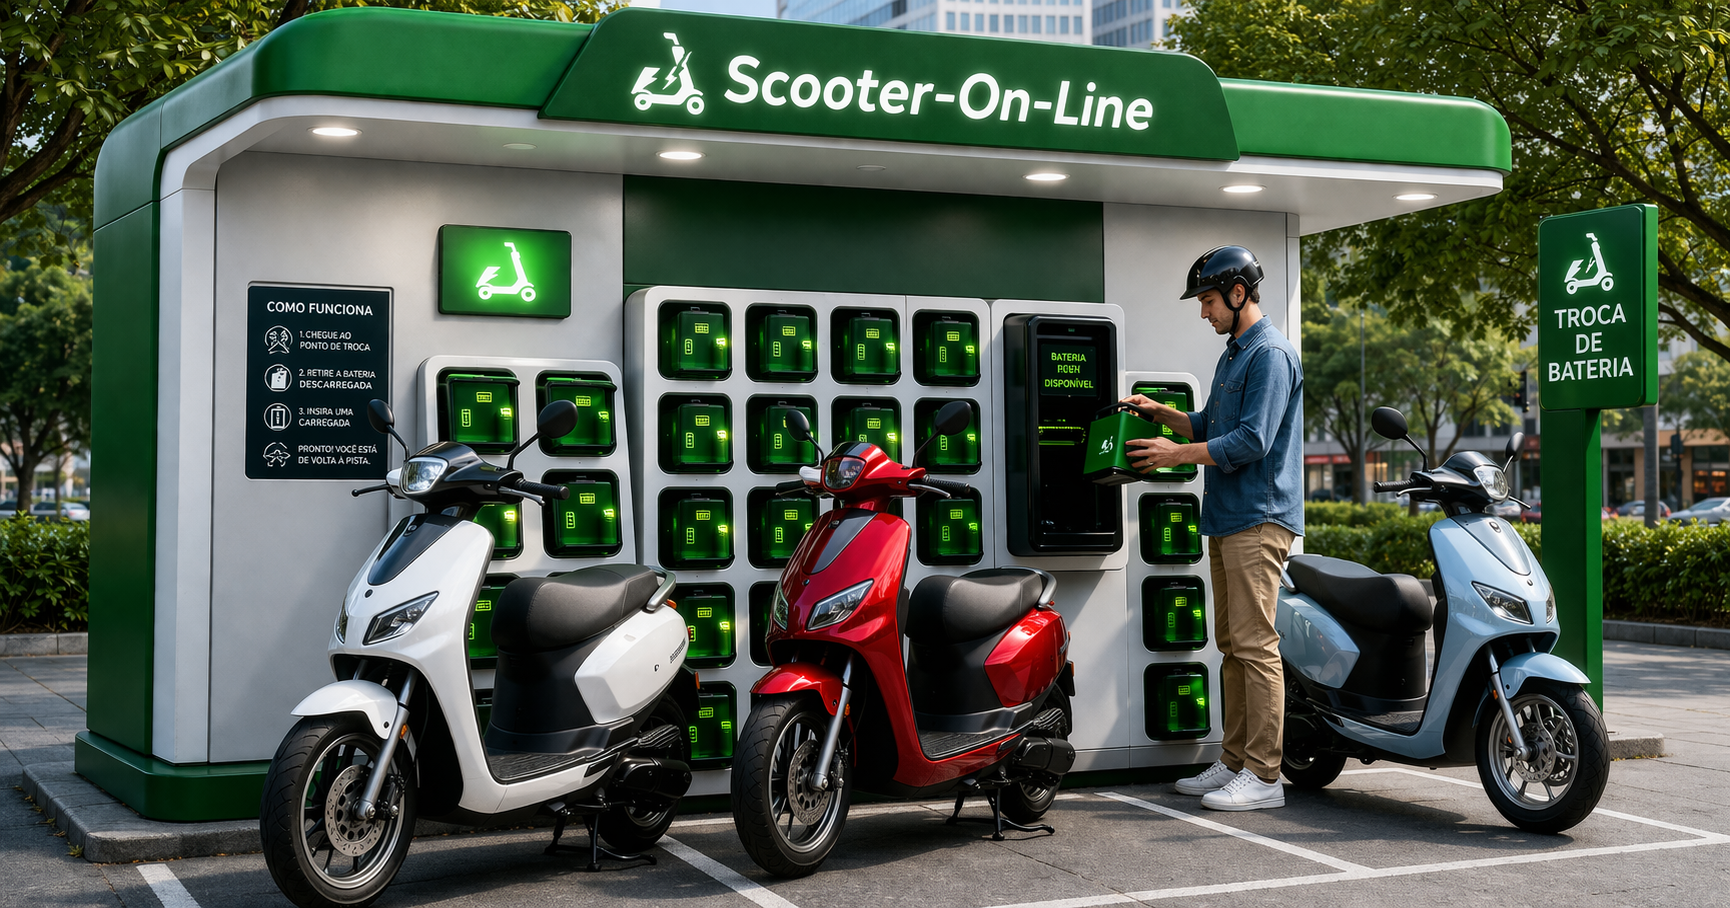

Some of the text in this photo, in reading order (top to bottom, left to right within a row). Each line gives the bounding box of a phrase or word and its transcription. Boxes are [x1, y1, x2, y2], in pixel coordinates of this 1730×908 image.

[724, 53, 1154, 132] Scooter-On-Line
[266, 300, 374, 316] COMO FUNCIONA
[1554, 303, 1627, 329] TROCA
[299, 330, 352, 341] 1. CHEGUE AO
[299, 340, 371, 352] PONTO DE TROCA
[1575, 331, 1603, 354] DE
[1051, 352, 1087, 362] BATERIA
[298, 368, 377, 379] 2. RETIRE A BATERIA
[1548, 356, 1634, 382] BATERIA
[299, 380, 373, 390] DESCARREGADA
[1044, 377, 1094, 389] DISPONÍVEL
[298, 407, 354, 417] 3. INSIRA UMA
[298, 418, 351, 428] CARREGADA
[297, 443, 378, 454] PRONTO! VOCÊ ESTÁ
[298, 456, 310, 465] DE
[310, 456, 337, 465] VOLTA
[345, 456, 371, 465] PISTA.
